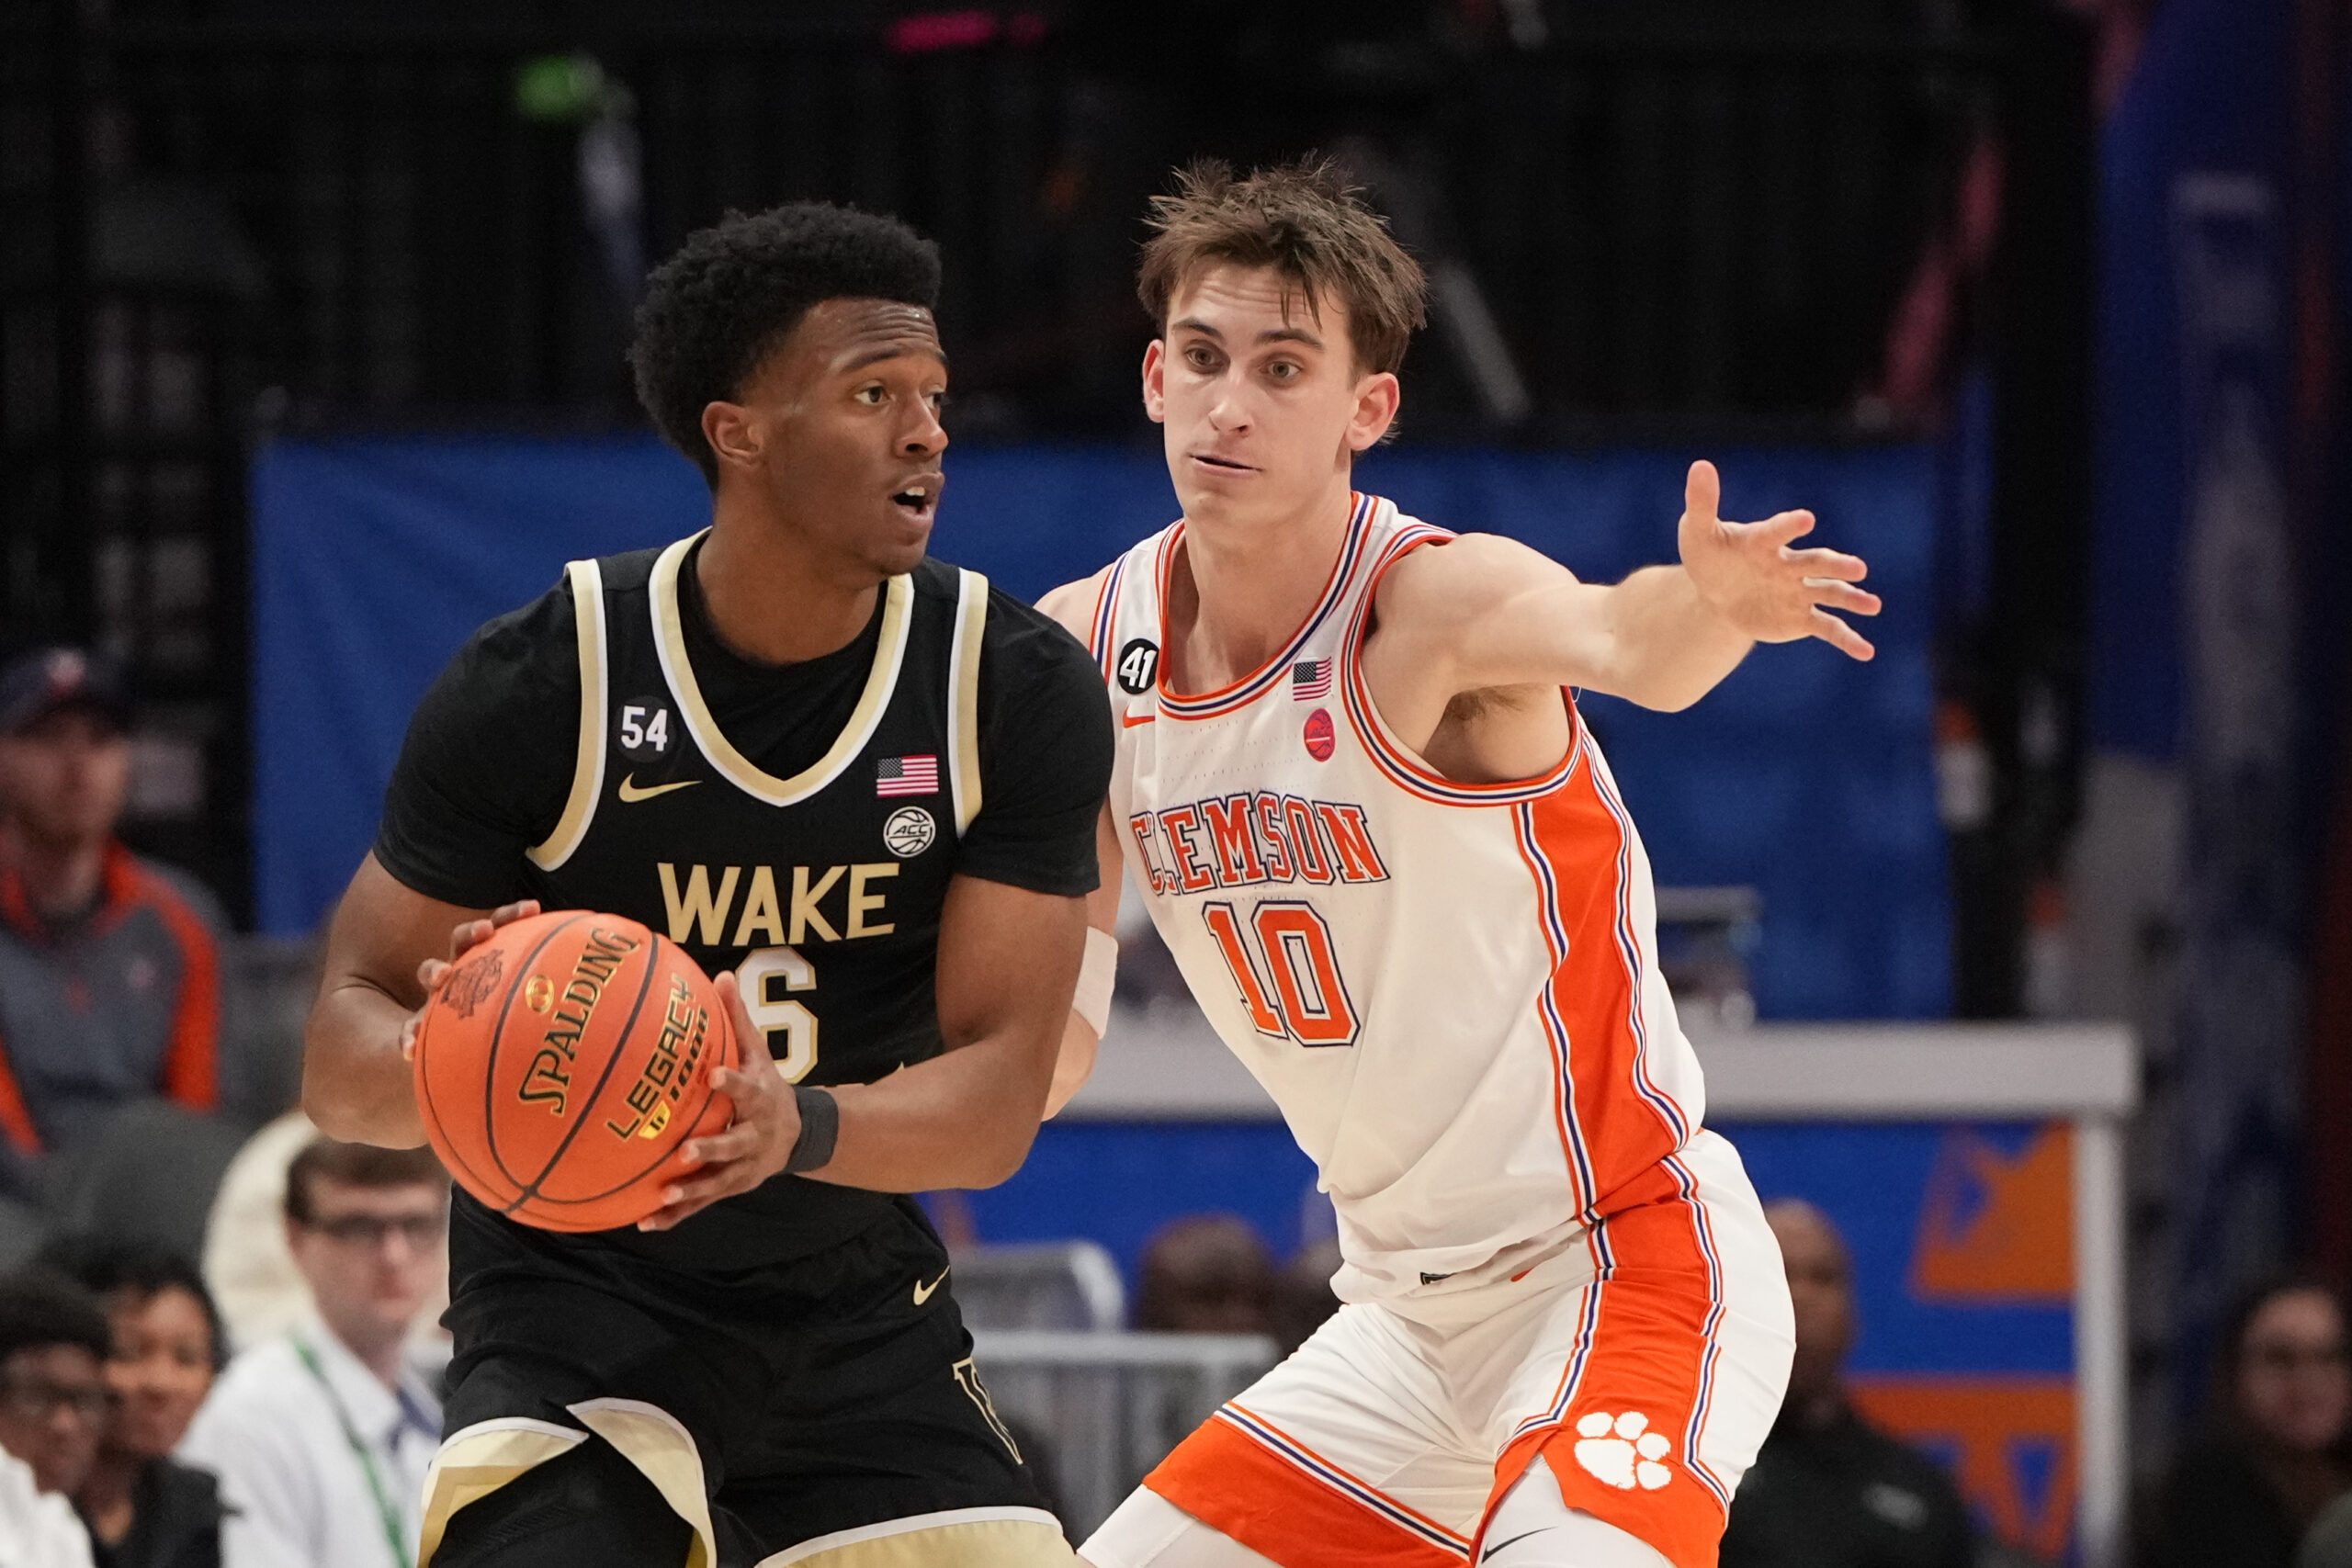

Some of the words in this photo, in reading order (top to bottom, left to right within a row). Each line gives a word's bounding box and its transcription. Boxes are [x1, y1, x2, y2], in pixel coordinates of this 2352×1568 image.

[1119, 647, 1157, 689] 41
[620, 705, 668, 751] 54
[893, 823, 931, 835] ACC
[657, 862, 900, 947] WAKE
[518, 926, 640, 1117] SPALDING
[735, 945, 818, 1085] 6
[1202, 900, 1362, 1048] 10
[605, 973, 695, 1140] LEGACY
[669, 1005, 709, 1101] 1000
